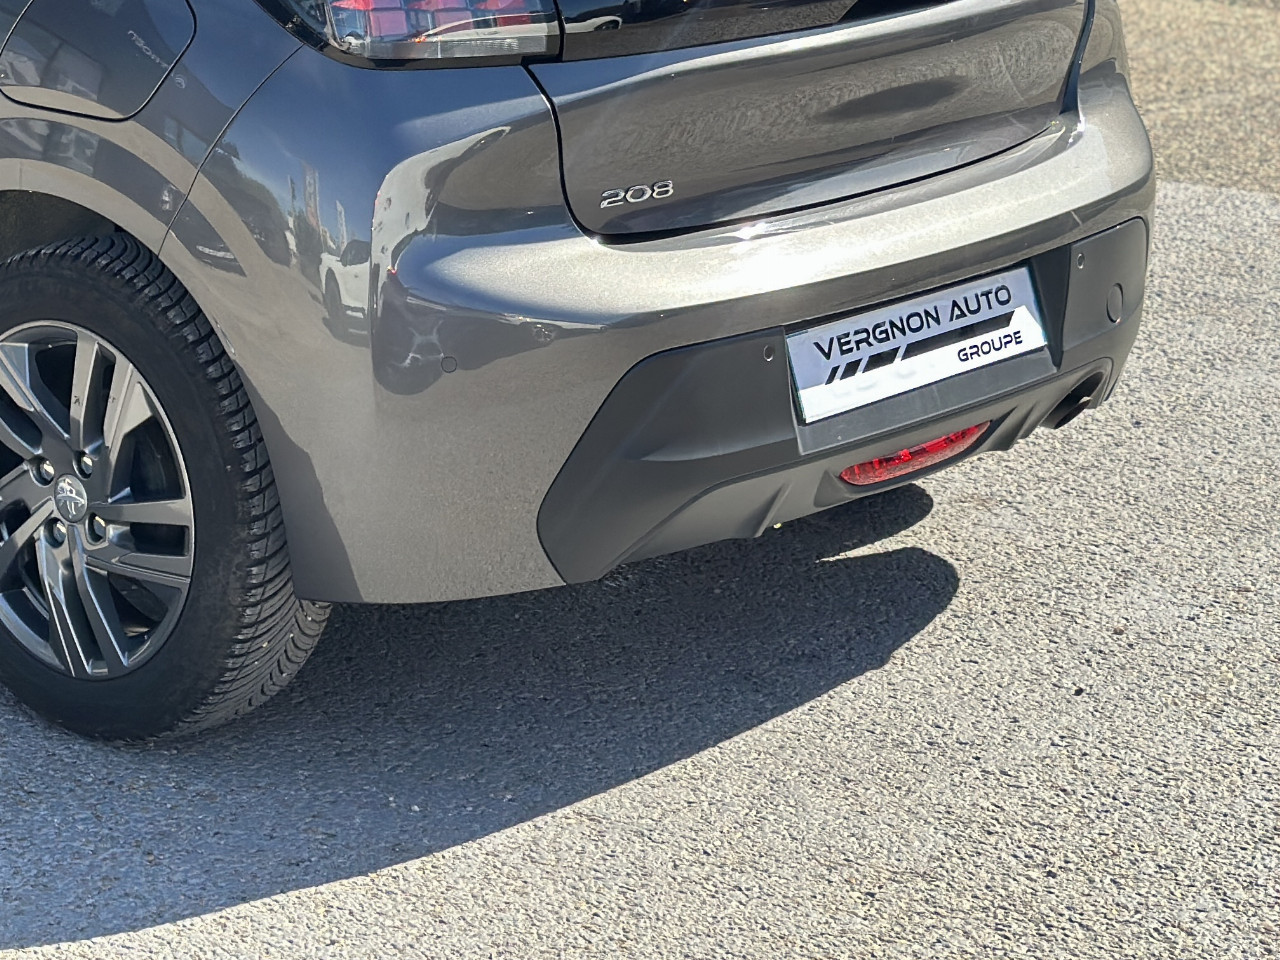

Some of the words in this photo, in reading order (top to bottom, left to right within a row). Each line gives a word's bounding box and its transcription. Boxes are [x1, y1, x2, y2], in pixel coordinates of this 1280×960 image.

[600, 180, 674, 209] 208
[814, 305, 941, 360] VERGNON
[949, 285, 1012, 322] AUTO
[958, 330, 1023, 362] GROUPE
